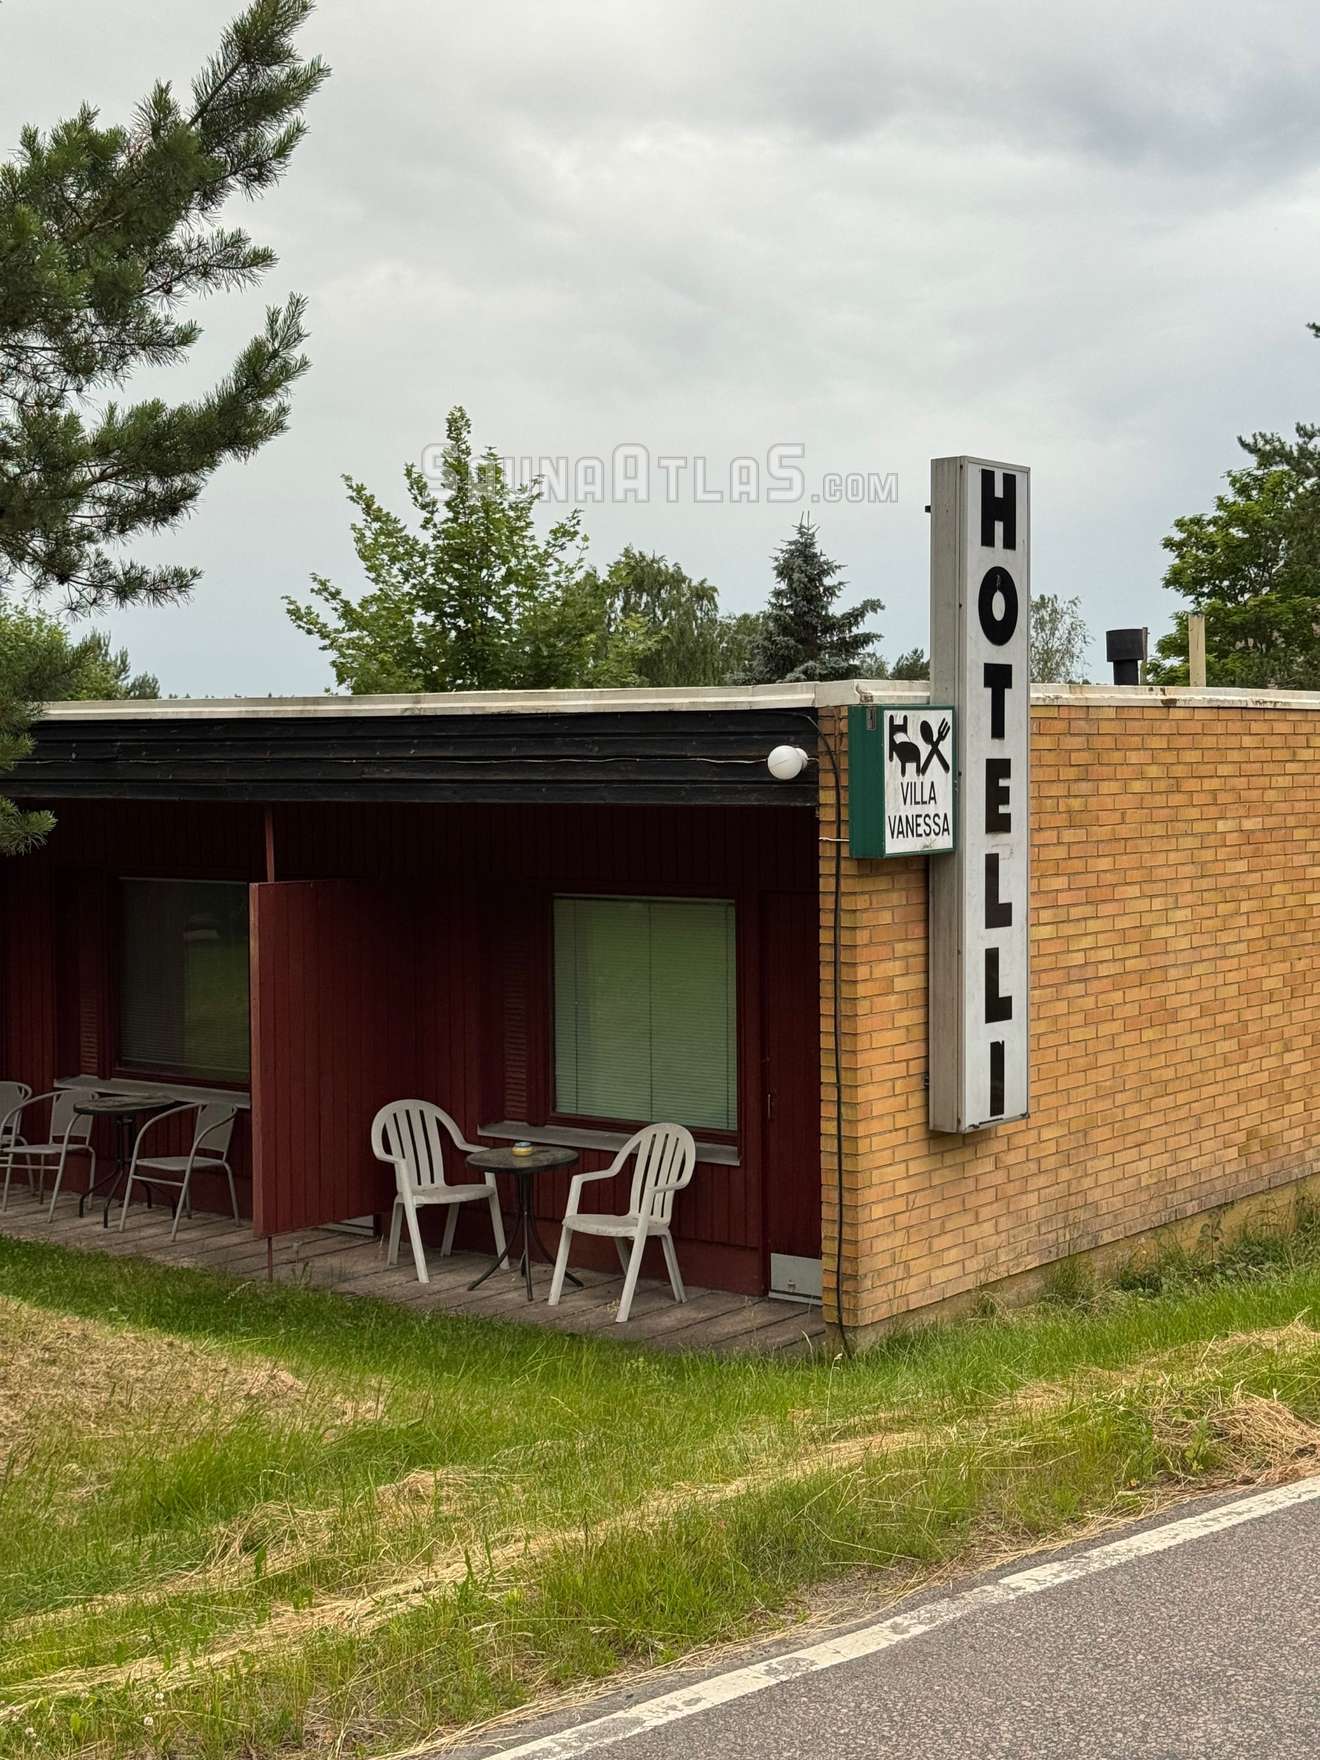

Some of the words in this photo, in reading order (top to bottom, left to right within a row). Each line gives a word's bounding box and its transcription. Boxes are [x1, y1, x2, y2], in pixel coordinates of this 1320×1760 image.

[900, 781, 937, 805] VILLA
[978, 469, 1018, 1117] HOTELLI
[888, 812, 951, 839] VANESSA
